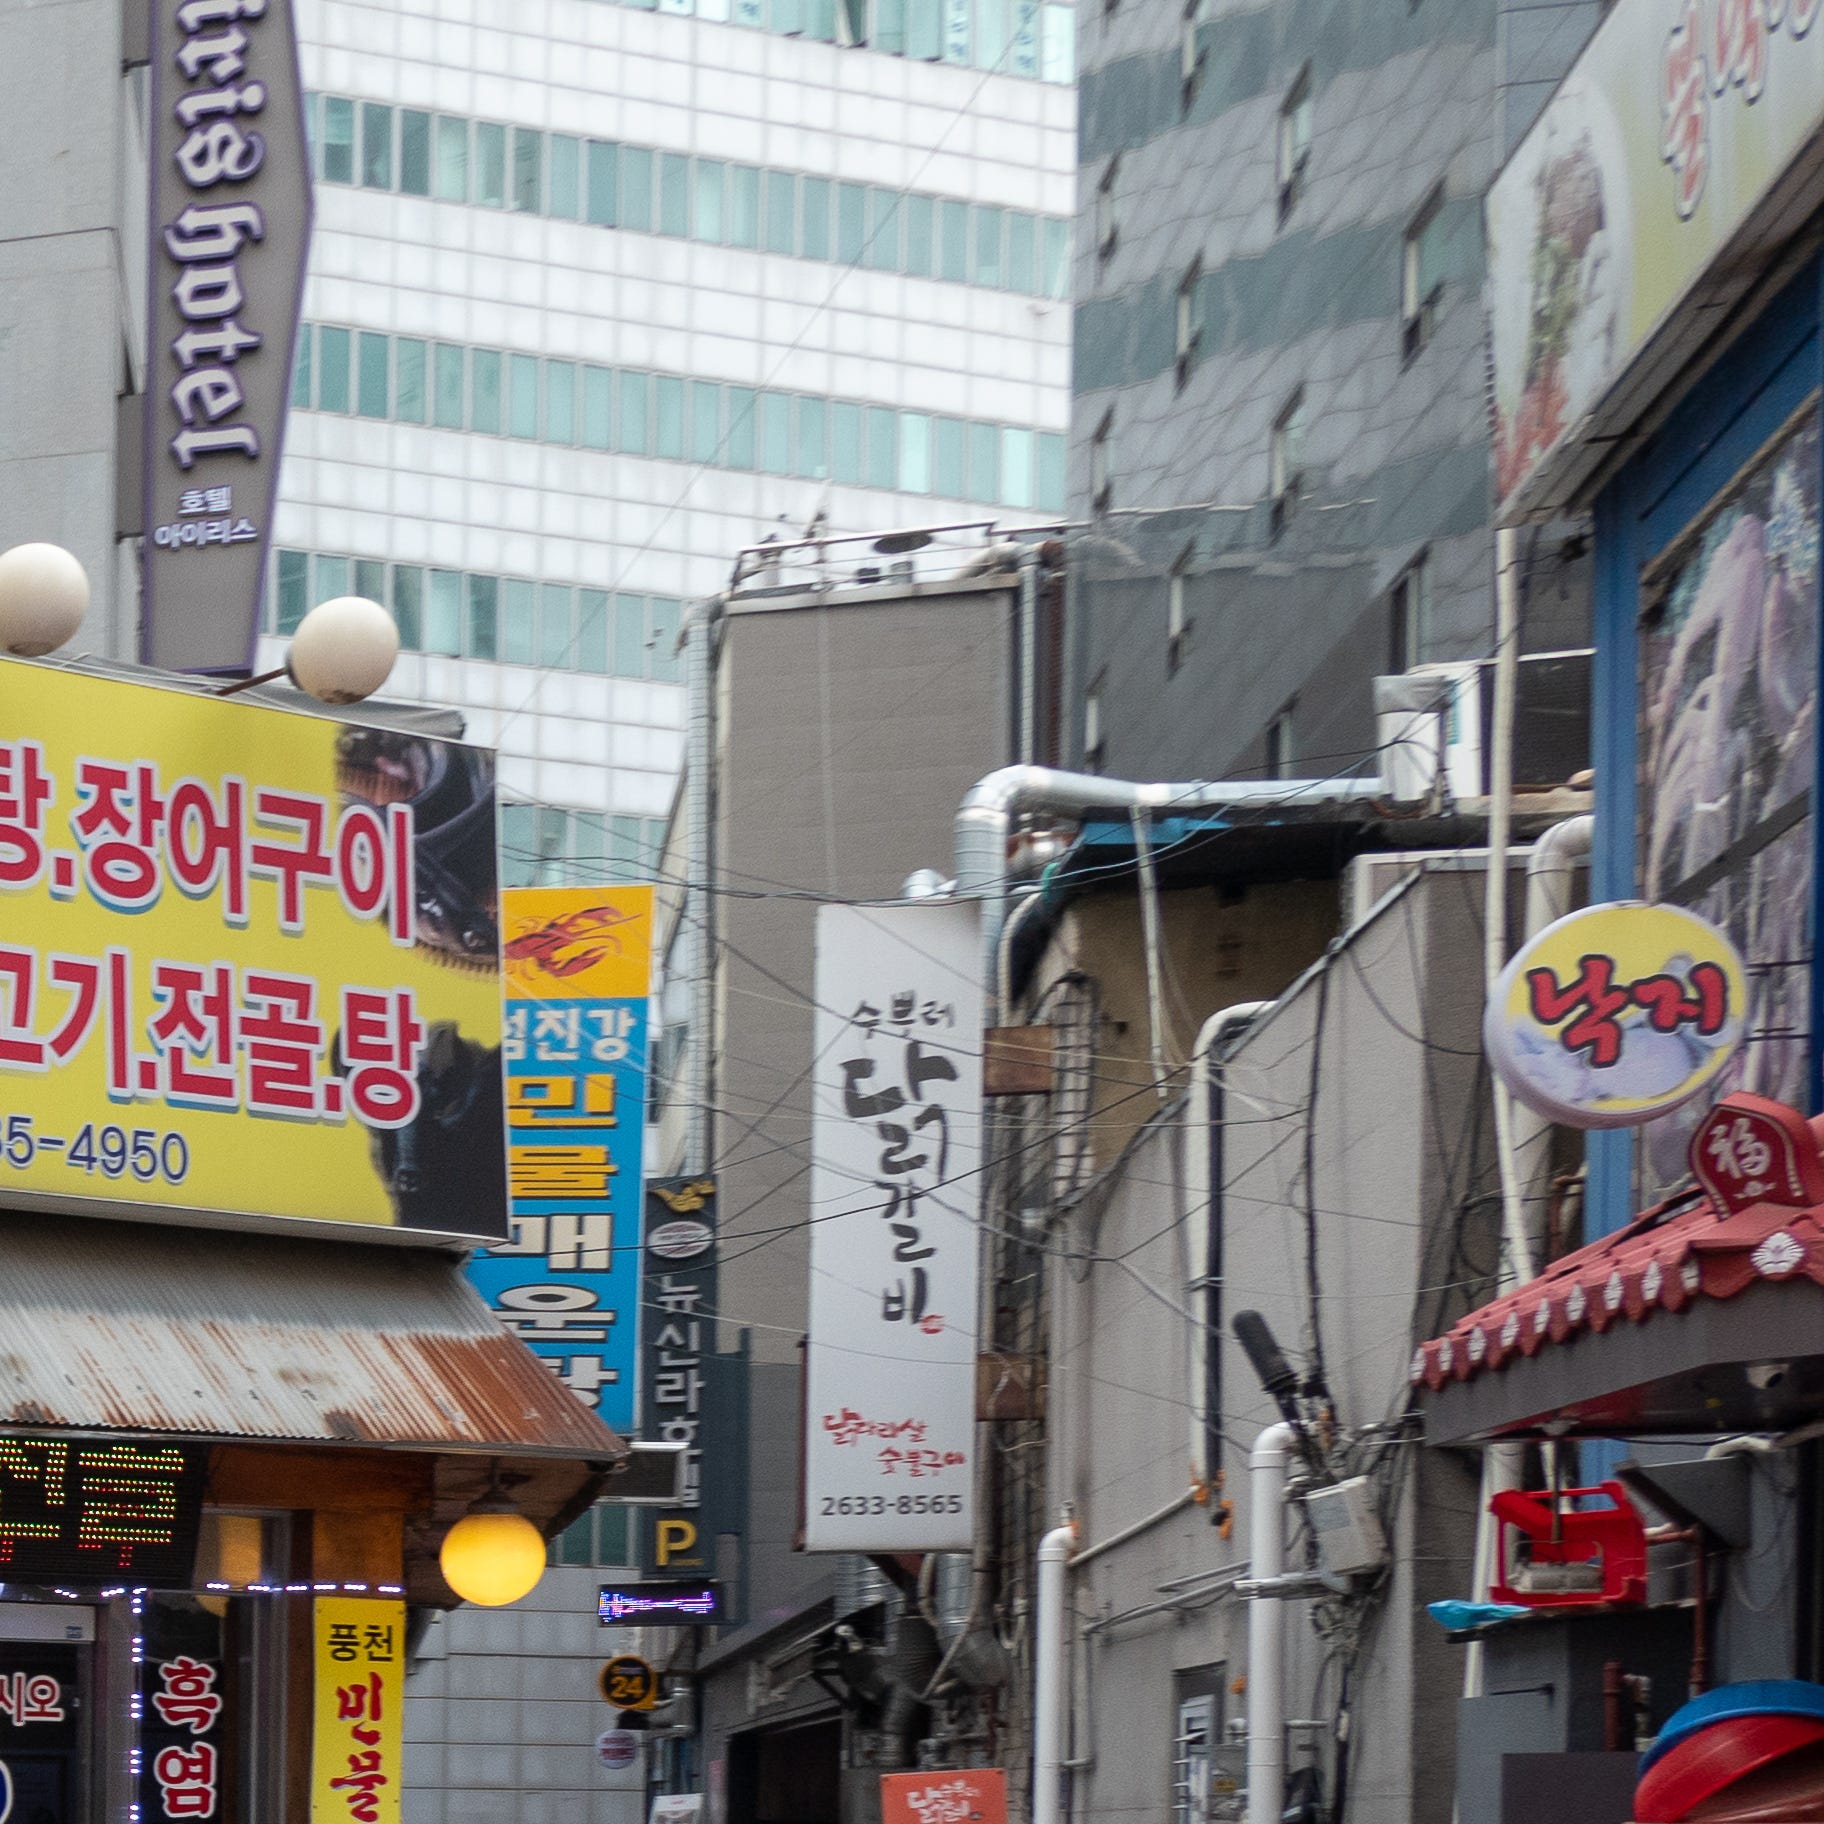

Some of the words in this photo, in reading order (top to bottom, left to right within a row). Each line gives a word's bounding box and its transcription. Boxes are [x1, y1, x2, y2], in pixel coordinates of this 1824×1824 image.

[164, 203, 263, 469] hotel
[177, 485, 232, 514] 호텔
[155, 518, 257, 551] 아이리스
[1526, 954, 1728, 1068] 낙지
[840, 1041, 959, 1325] 닭갈비
[821, 1495, 962, 1516] 2633-8565
[655, 1520, 698, 1566] P
[327, 1622, 394, 1664] 풍천
